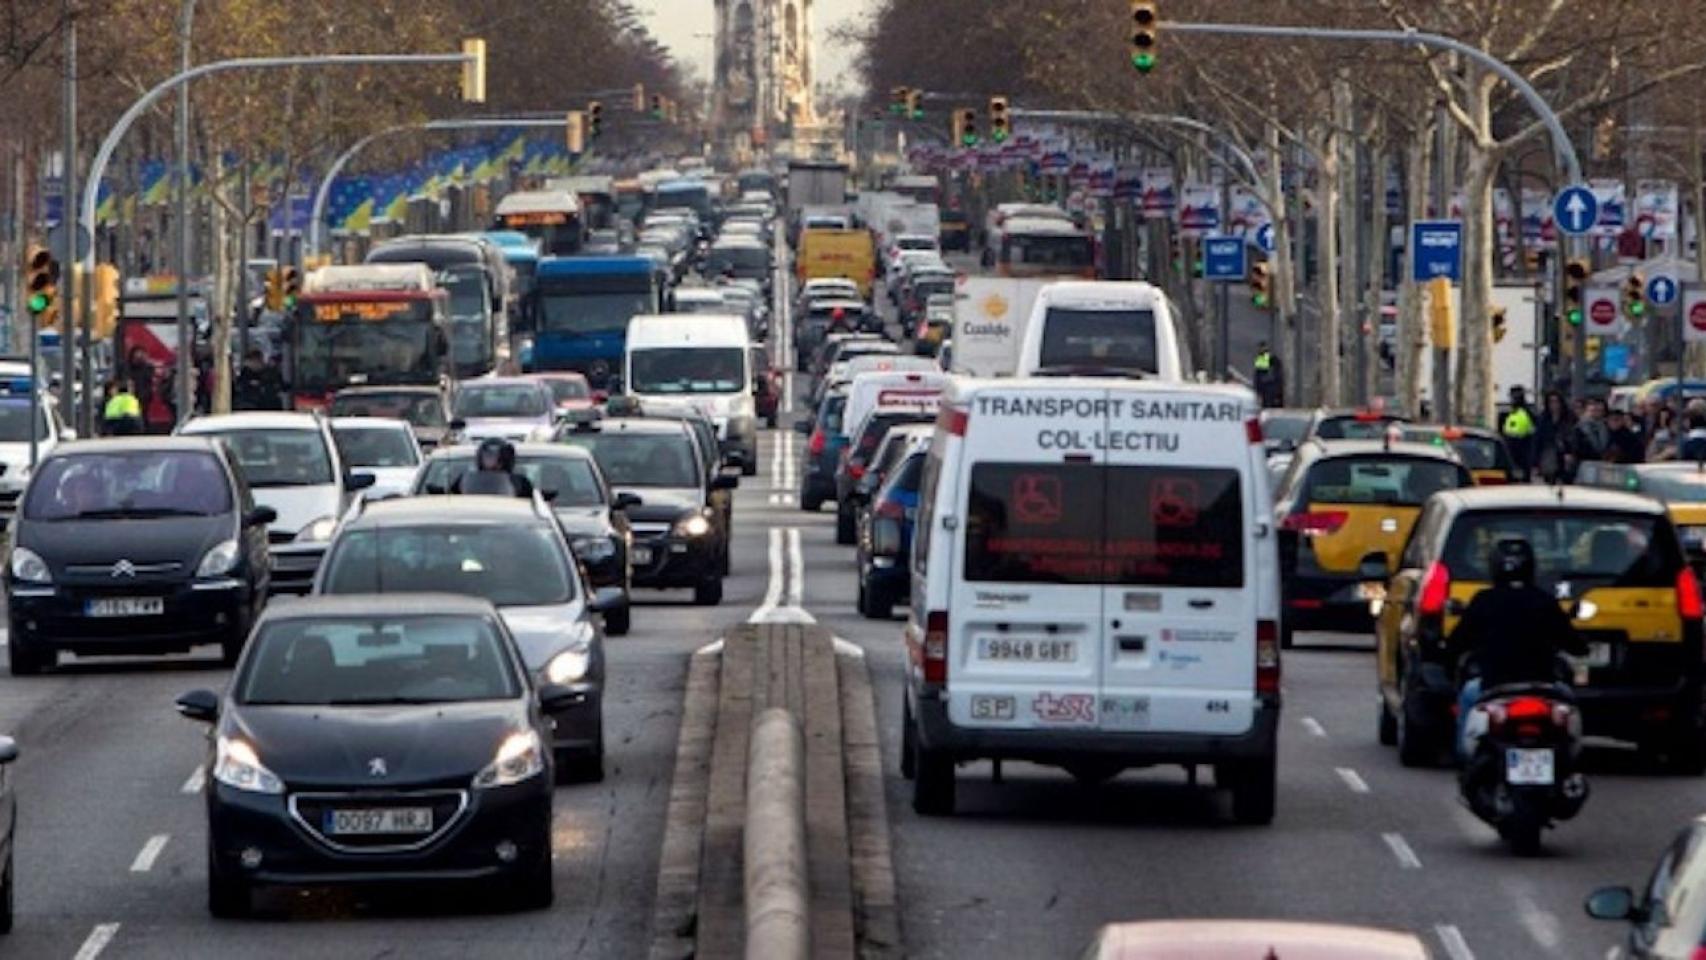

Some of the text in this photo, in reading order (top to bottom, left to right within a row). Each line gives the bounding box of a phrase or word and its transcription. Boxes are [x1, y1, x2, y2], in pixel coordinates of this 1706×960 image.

[977, 397, 1242, 421] TRANSPORT SANITARI
[989, 640, 1072, 660] 9948 GBT
[976, 698, 1009, 717] SP
[338, 808, 431, 832] 0097 HRJ
